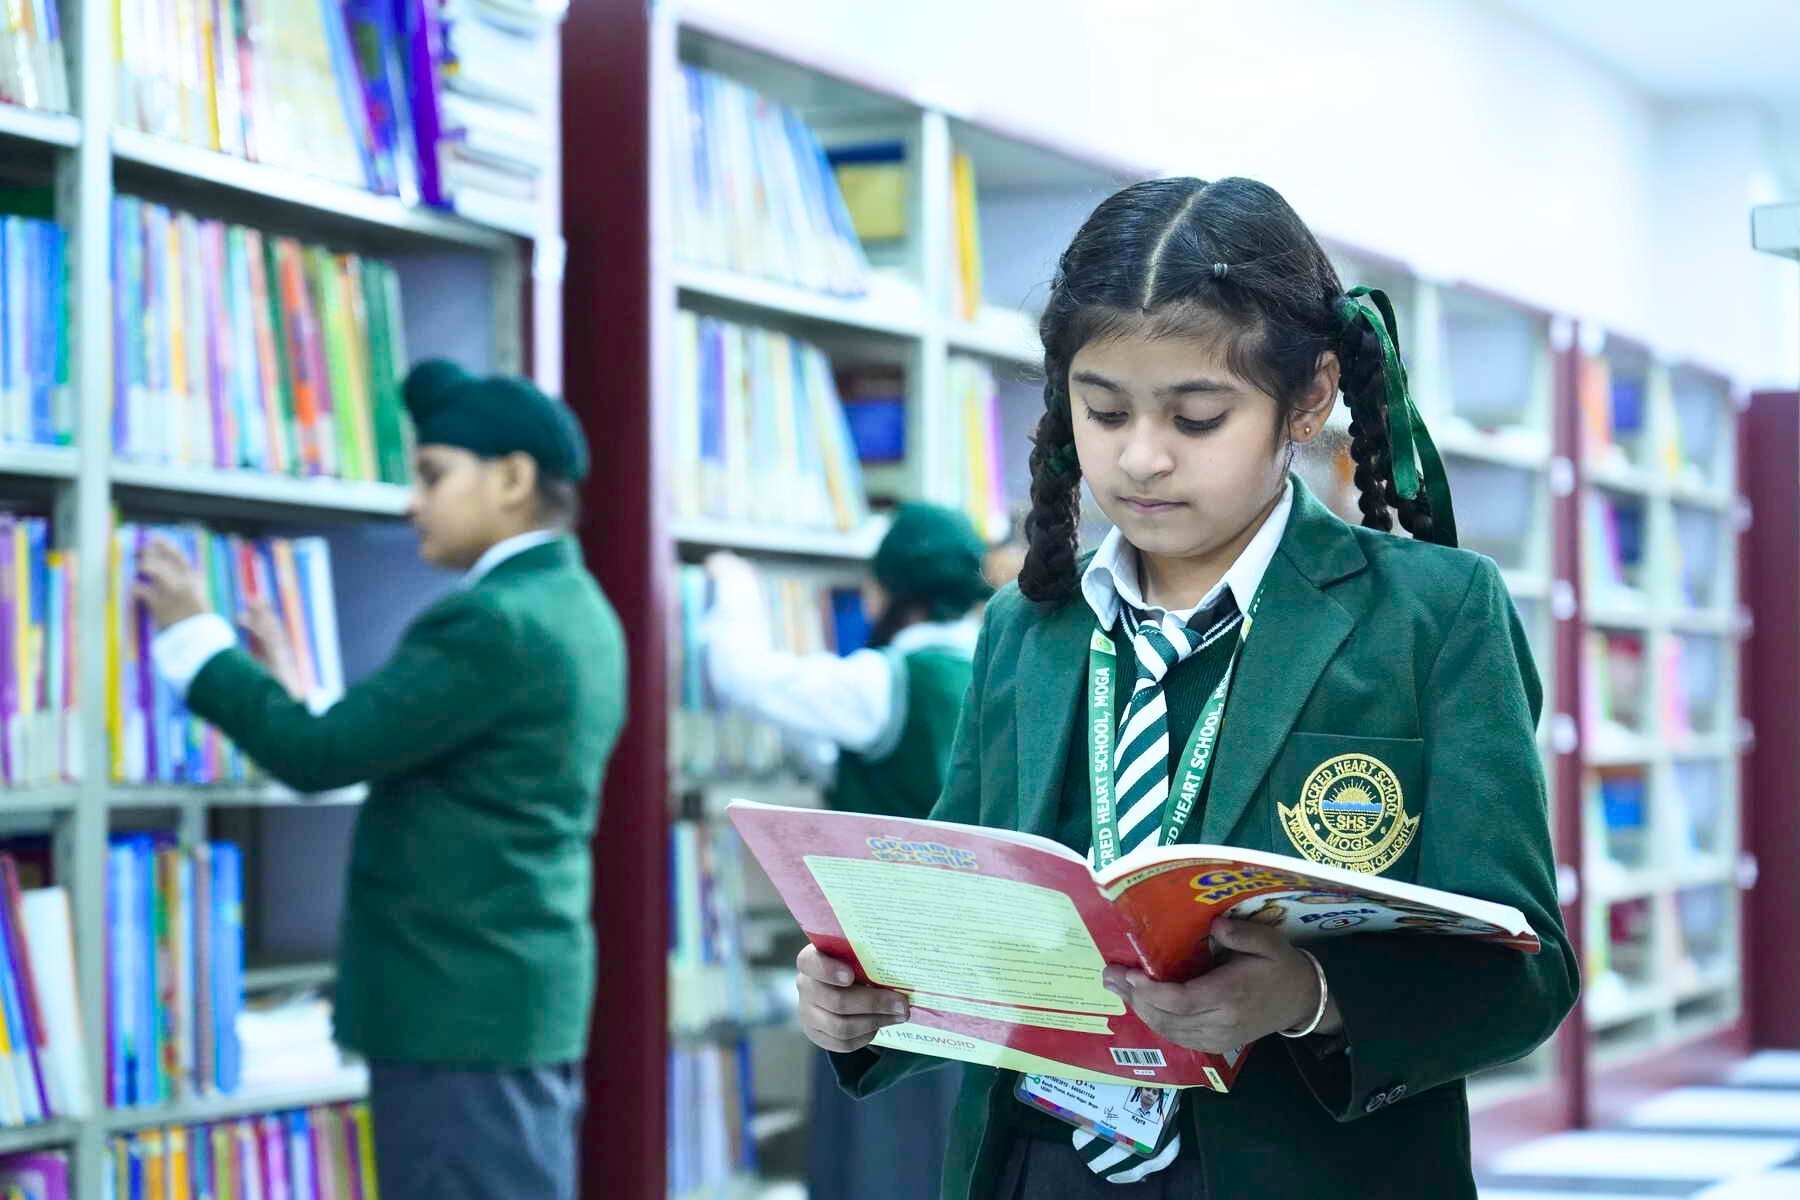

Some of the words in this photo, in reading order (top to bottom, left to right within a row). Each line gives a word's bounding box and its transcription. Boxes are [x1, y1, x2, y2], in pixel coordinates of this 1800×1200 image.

[1095, 667, 1111, 708] MOGA
[1094, 711, 1111, 772] SCHOOL,
[1172, 770, 1202, 825] HEART
[1190, 702, 1225, 770] SCHOOL,
[1095, 776, 1111, 825] HEART
[1306, 770, 1333, 815] SACRED
[1334, 759, 1375, 776] HEART
[1375, 771, 1398, 817] SCHOOL
[1287, 819, 1314, 851] WALK
[1306, 847, 1322, 862] AS
[1374, 850, 1389, 867] OF
[1387, 824, 1411, 856] LIGHT
[1325, 832, 1374, 851] MOGA
[1336, 814, 1368, 830] SHS
[1299, 907, 1378, 923] Book
[895, 1030, 977, 1049] HEADWORD
